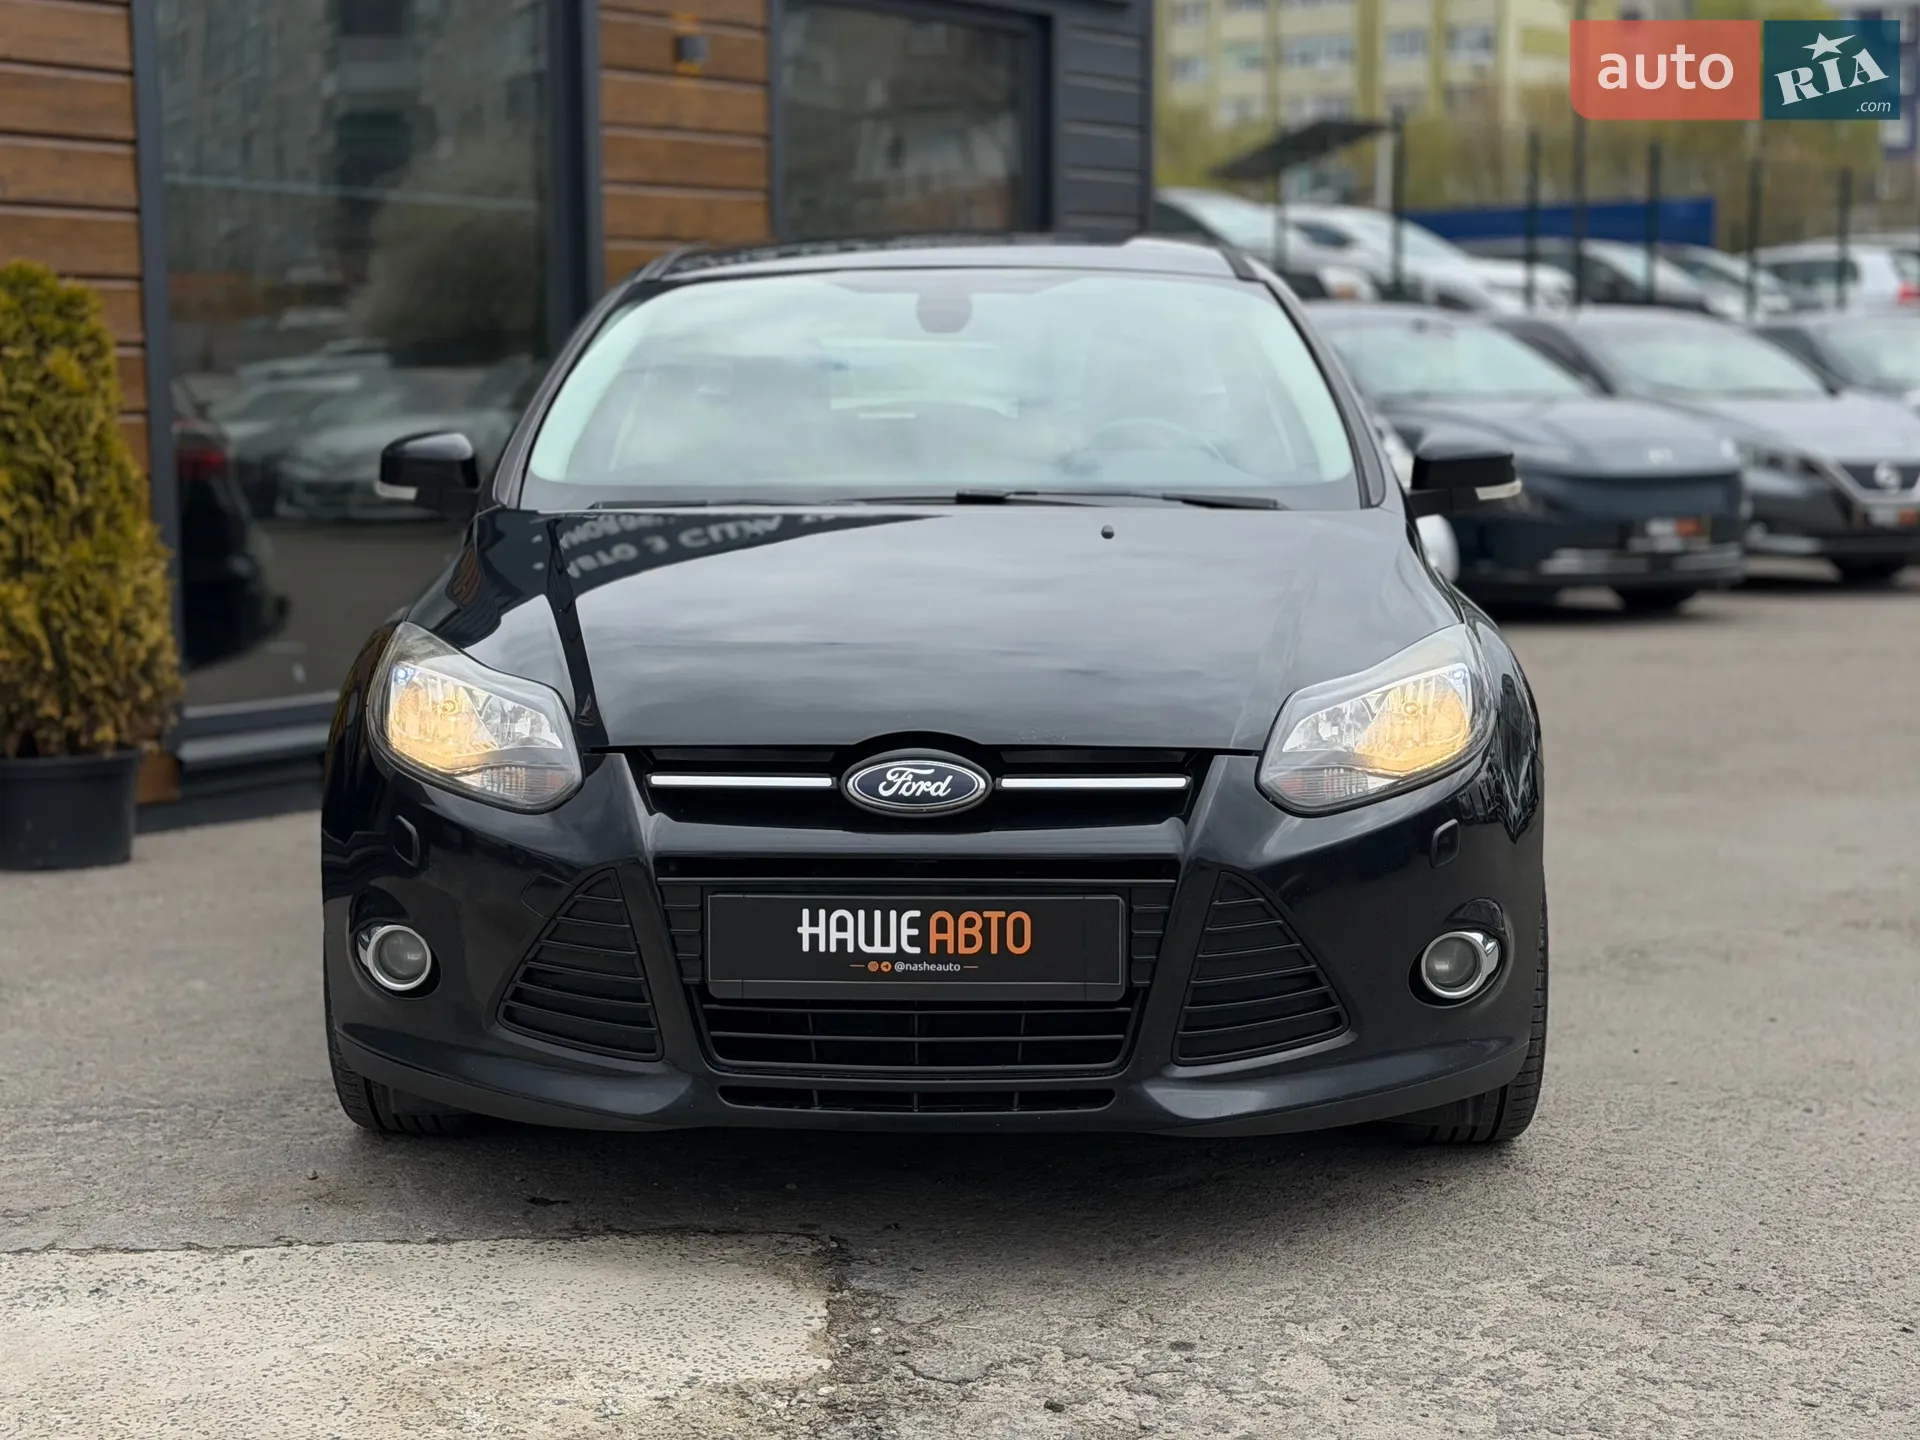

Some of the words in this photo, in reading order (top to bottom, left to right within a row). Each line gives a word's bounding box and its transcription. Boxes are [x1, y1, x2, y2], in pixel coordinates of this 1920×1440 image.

[878, 766, 954, 797] Ford
[796, 907, 922, 955] НАШЕ
[929, 909, 1033, 956] АВТО
[893, 960, 962, 974] @nasheauto
